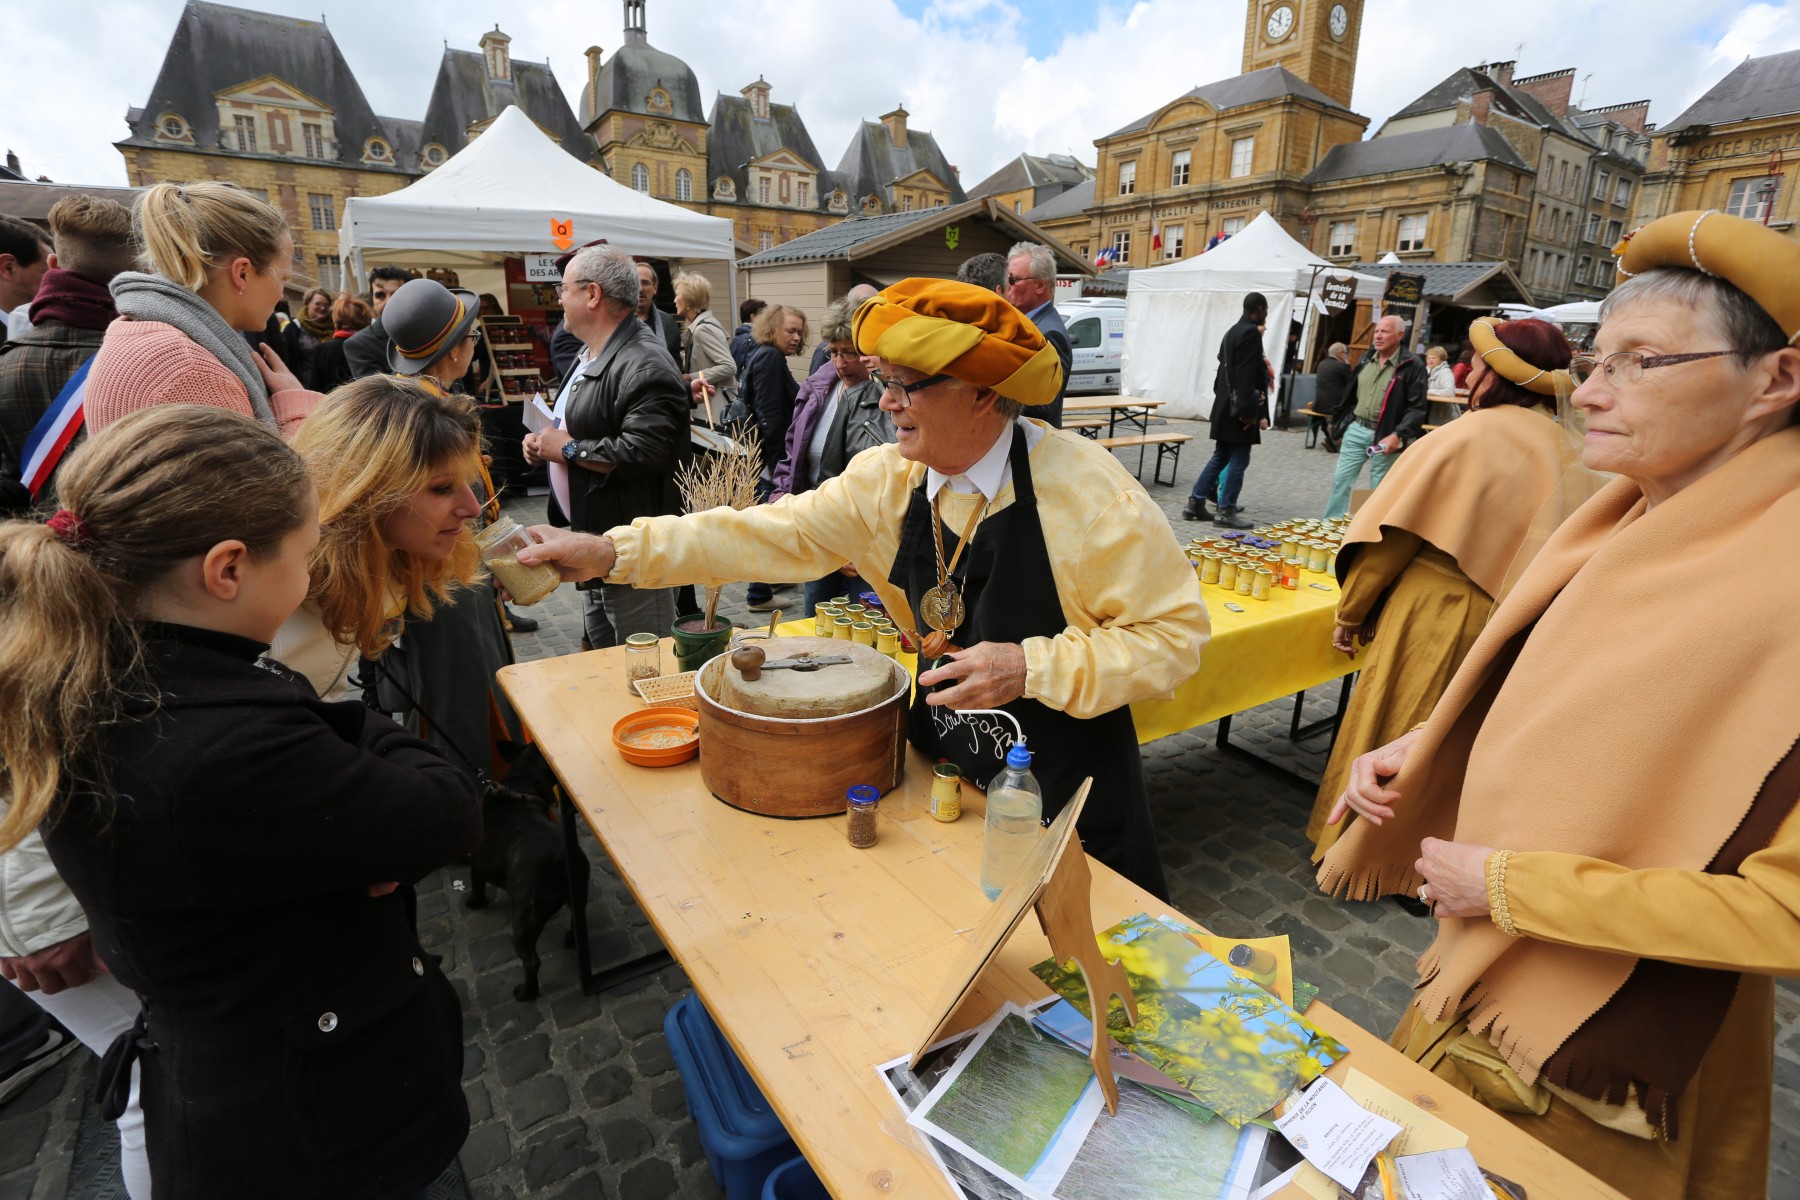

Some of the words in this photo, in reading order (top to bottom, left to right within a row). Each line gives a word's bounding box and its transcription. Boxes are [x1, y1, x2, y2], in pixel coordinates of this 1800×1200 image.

[1699, 138, 1744, 158] CAFÉ
[557, 225, 567, 236] Q
[948, 231, 956, 240] 17
[538, 258, 547, 266] LE
[550, 258, 556, 266] S
[530, 268, 546, 276] DES
[1308, 1080, 1328, 1102] MOUTARDE
[1304, 1101, 1318, 1116] DIJON
